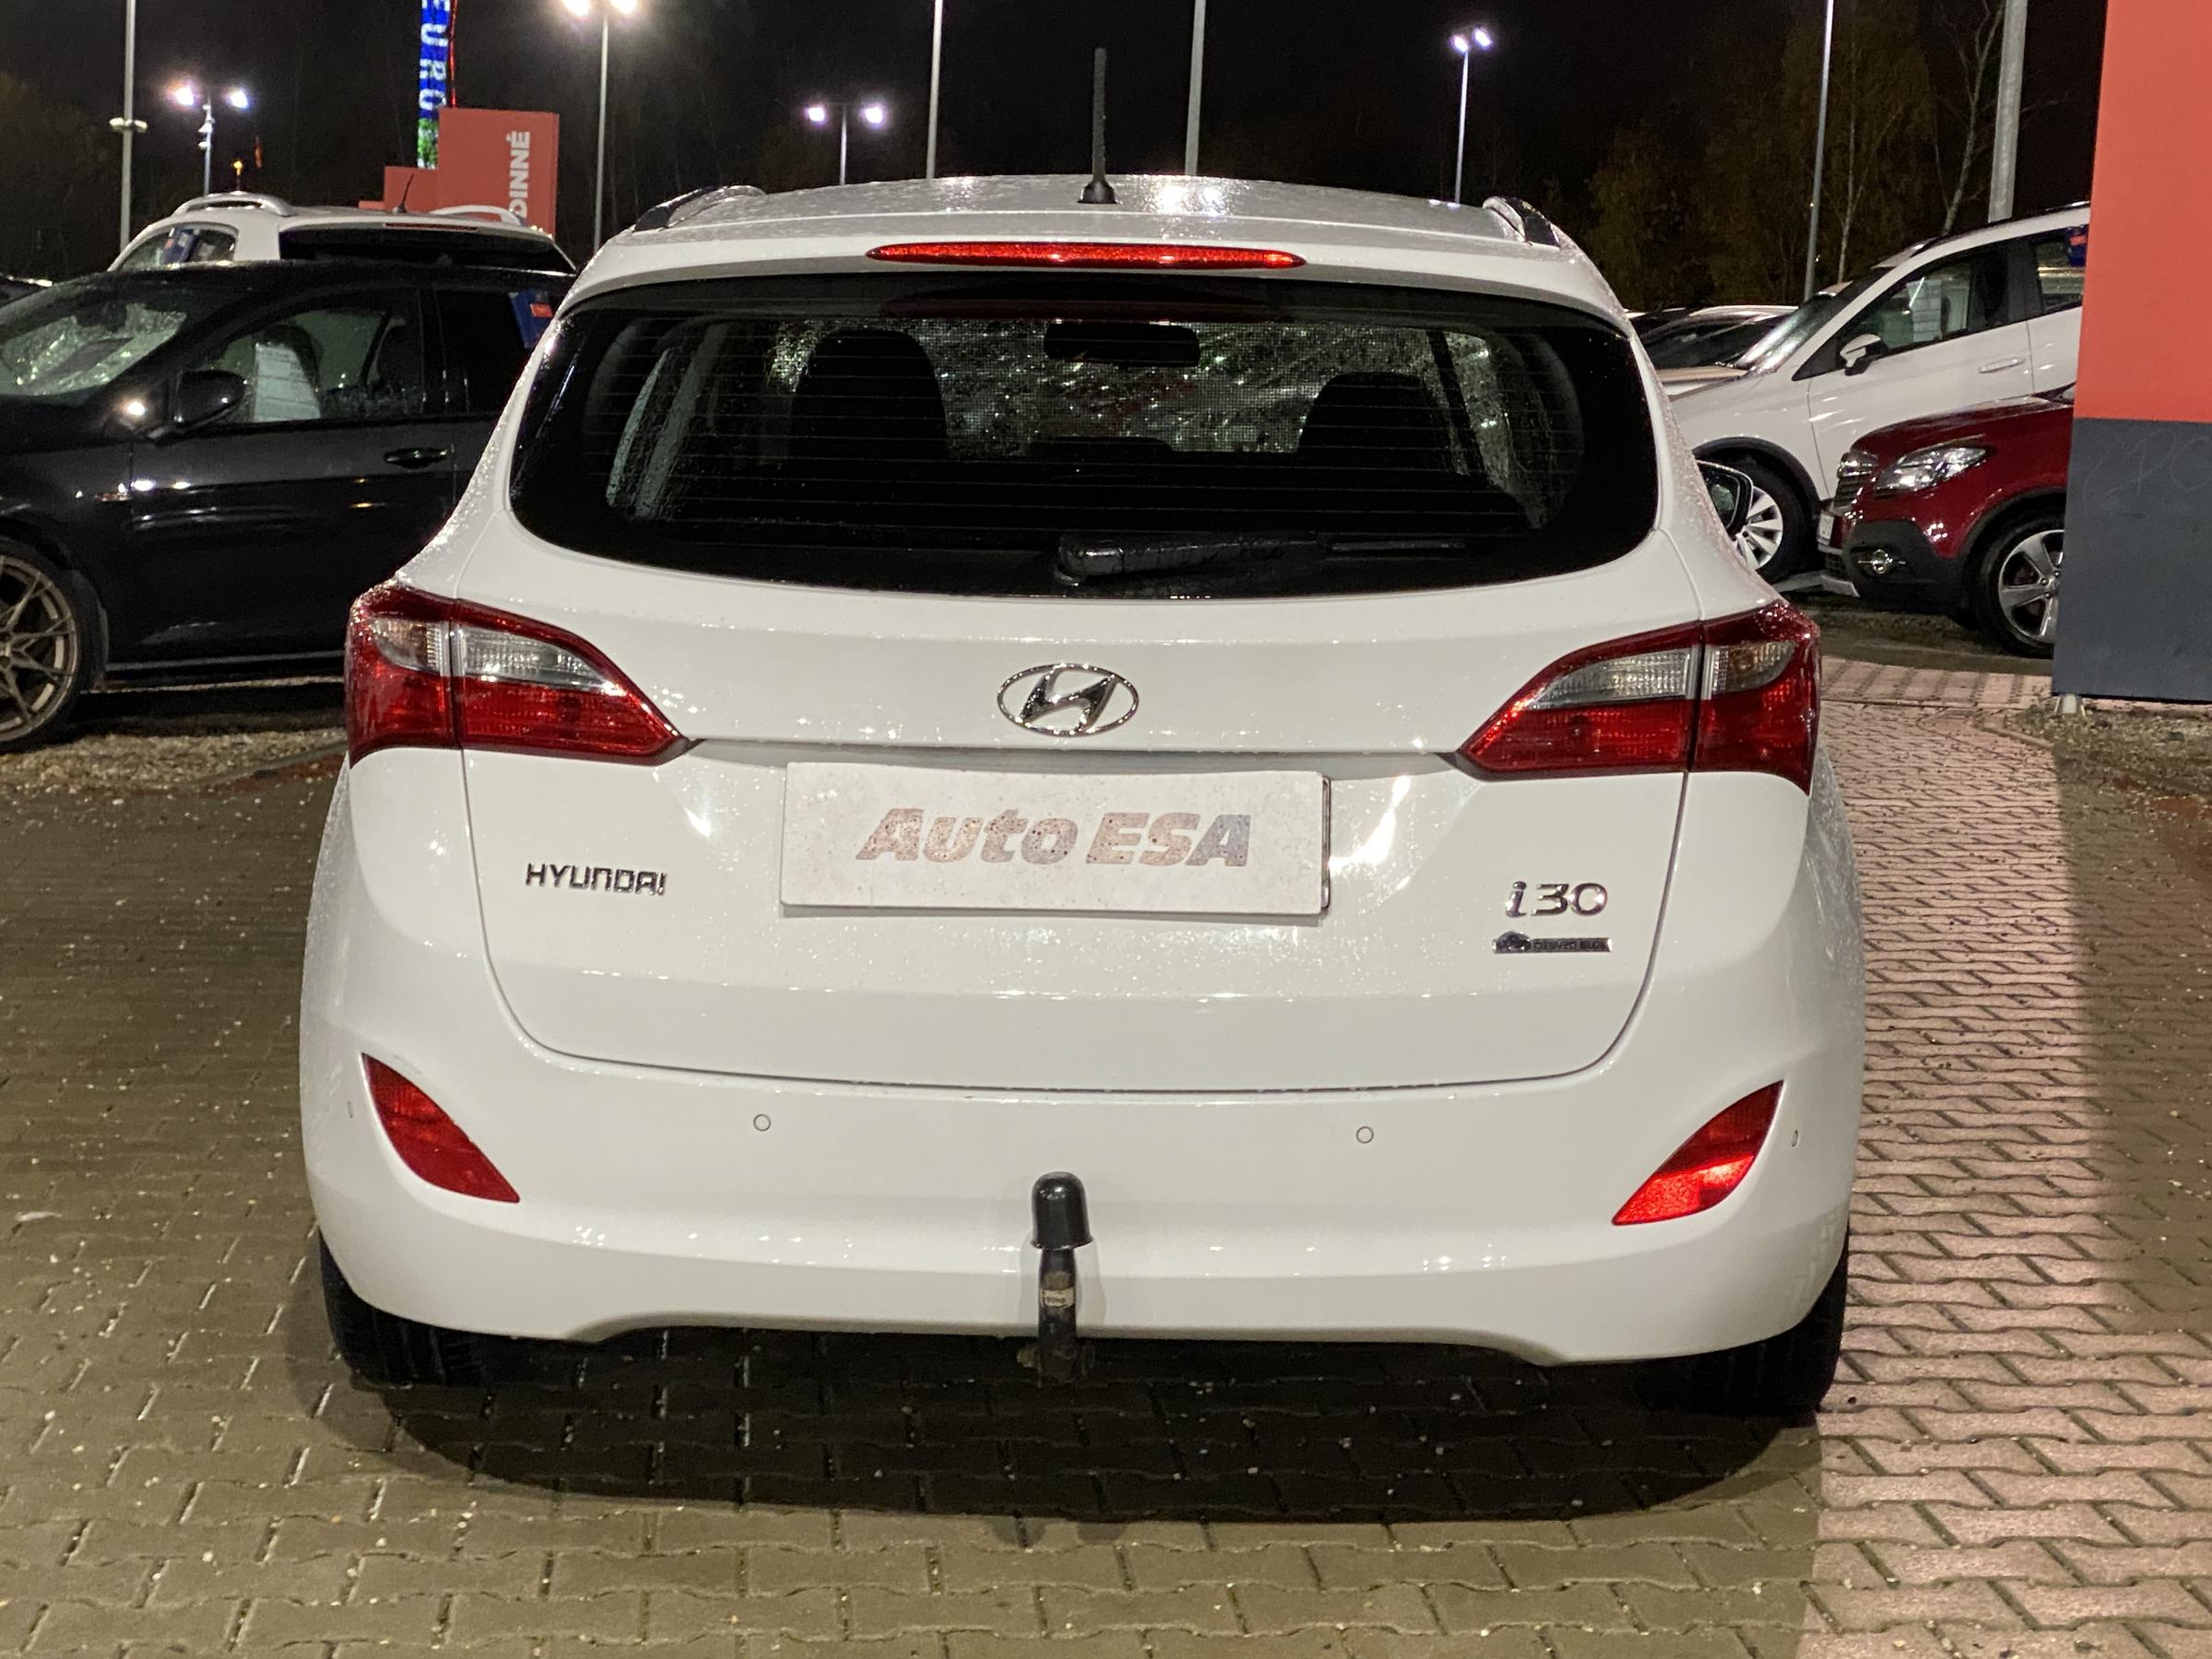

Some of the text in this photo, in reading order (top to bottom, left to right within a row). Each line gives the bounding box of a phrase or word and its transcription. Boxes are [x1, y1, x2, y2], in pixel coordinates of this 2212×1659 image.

[855, 807, 1252, 867] Auto ESA
[525, 863, 667, 896] HYUNDAI
[1505, 880, 1608, 918] i30
